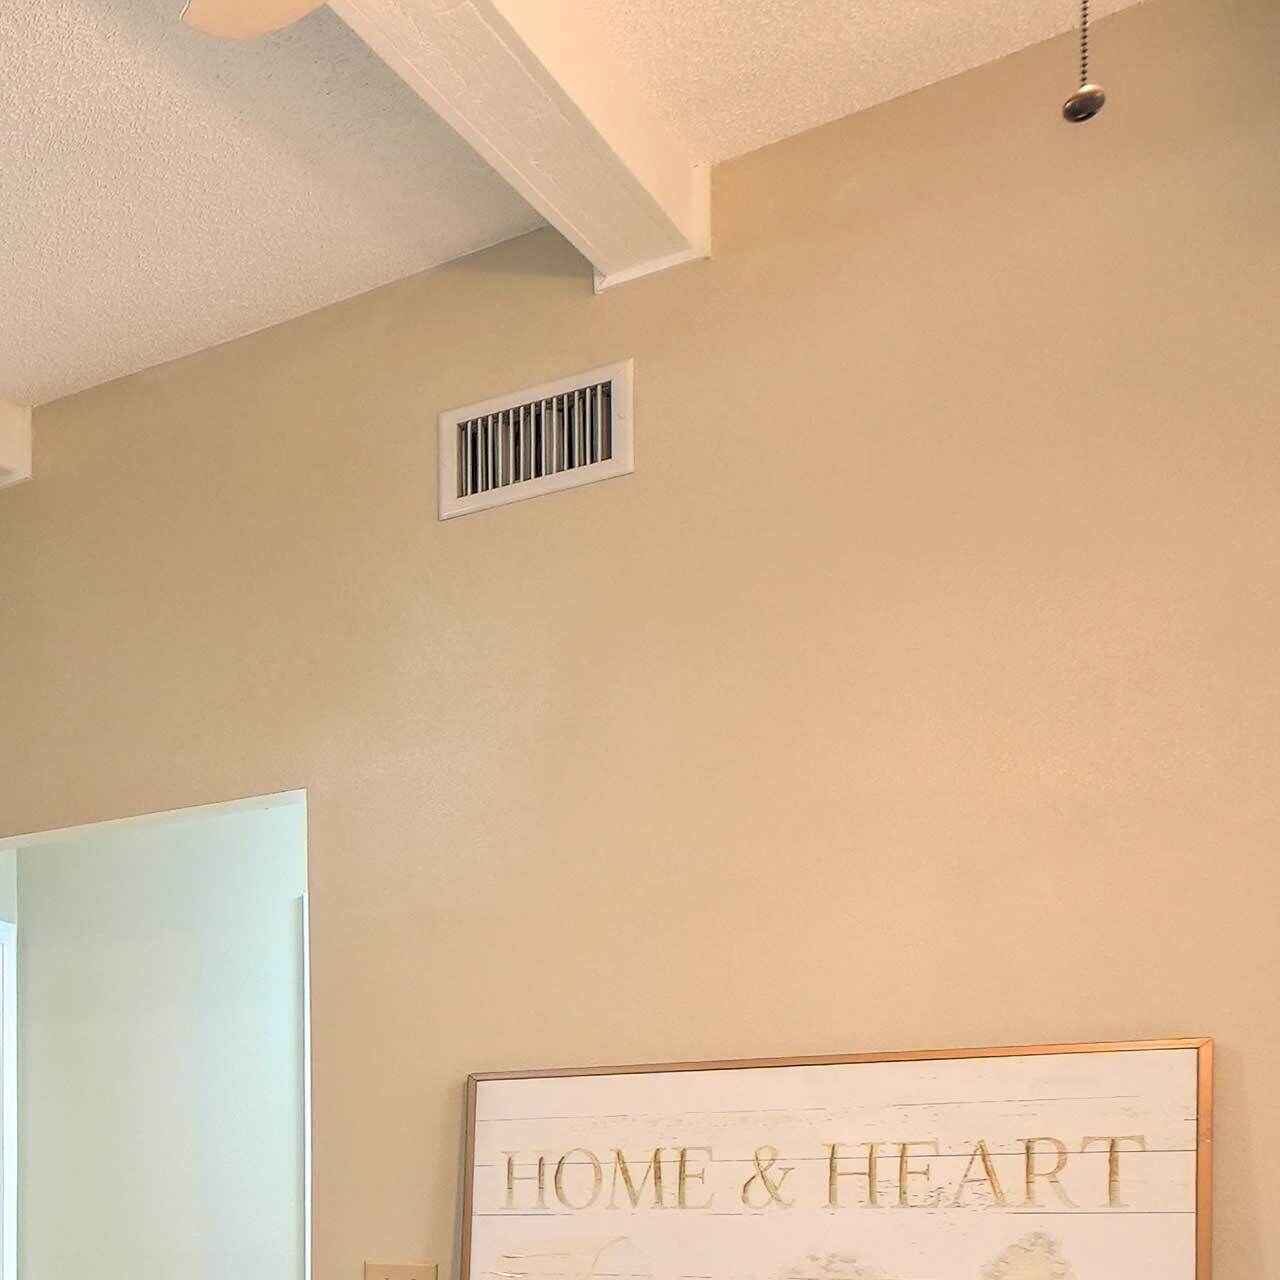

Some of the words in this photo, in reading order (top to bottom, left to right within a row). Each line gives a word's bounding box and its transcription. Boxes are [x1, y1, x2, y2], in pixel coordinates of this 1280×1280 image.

[499, 1145, 714, 1211] HOME
[741, 1144, 796, 1210] &
[821, 1134, 1147, 1209] HEART
